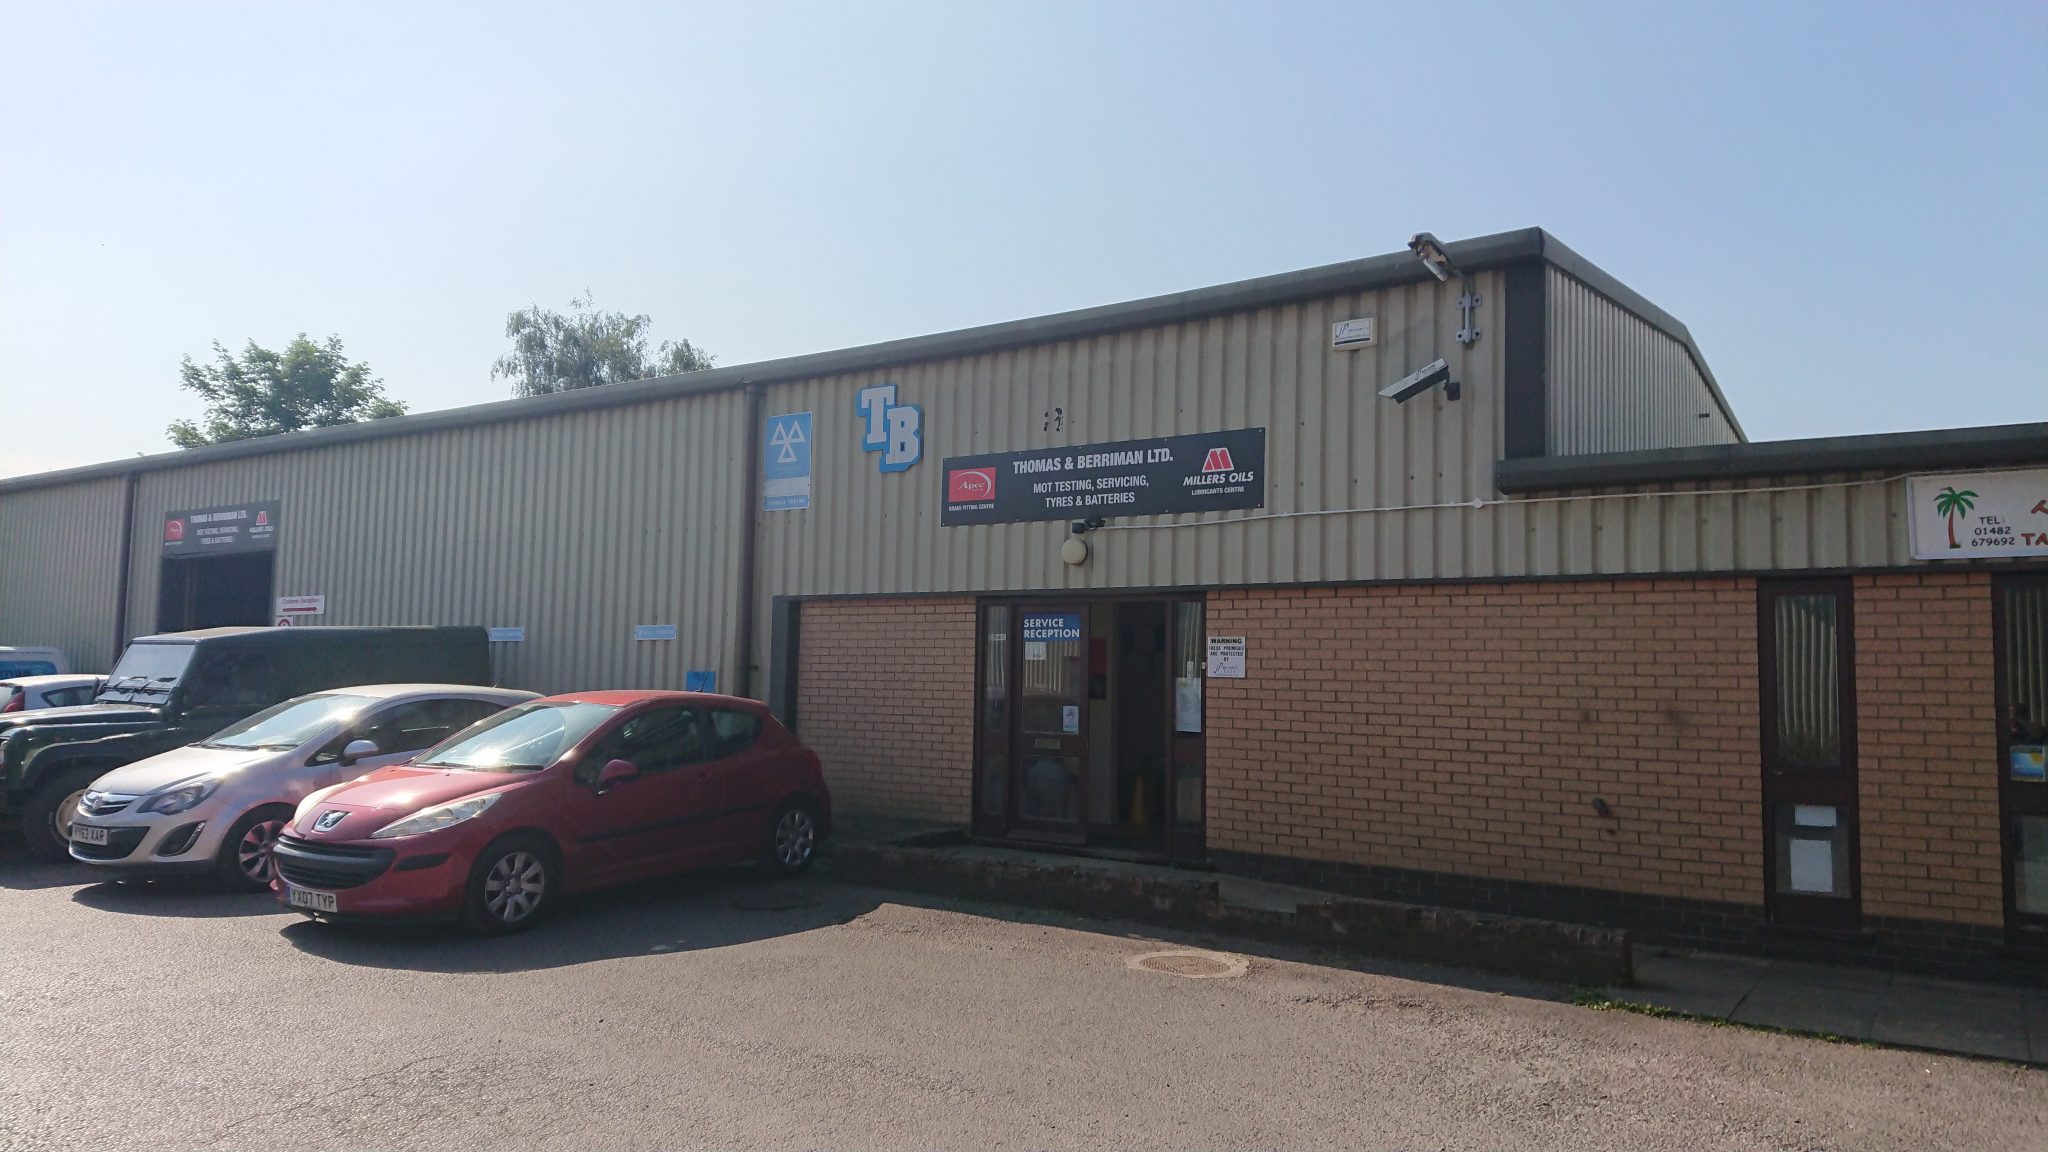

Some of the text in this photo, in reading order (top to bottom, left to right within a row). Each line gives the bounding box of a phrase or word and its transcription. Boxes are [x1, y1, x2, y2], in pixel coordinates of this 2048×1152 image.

[1013, 447, 1174, 474] THOMAS & BERRIMAN LTD.
[1033, 474, 1149, 494] MOT TESTING, SERVICING,
[1182, 471, 1255, 487] MILLERS OILS
[1191, 486, 1245, 496] LUBRICANTS CENTRE
[1045, 491, 1135, 508] TYRES & BATTERIES
[1974, 526, 2011, 536] 01482
[1971, 537, 2015, 547] 679692
[1023, 618, 1064, 628] SERVICE
[1023, 628, 1080, 639] RECEPTION
[291, 888, 335, 909] YX07 TYP
